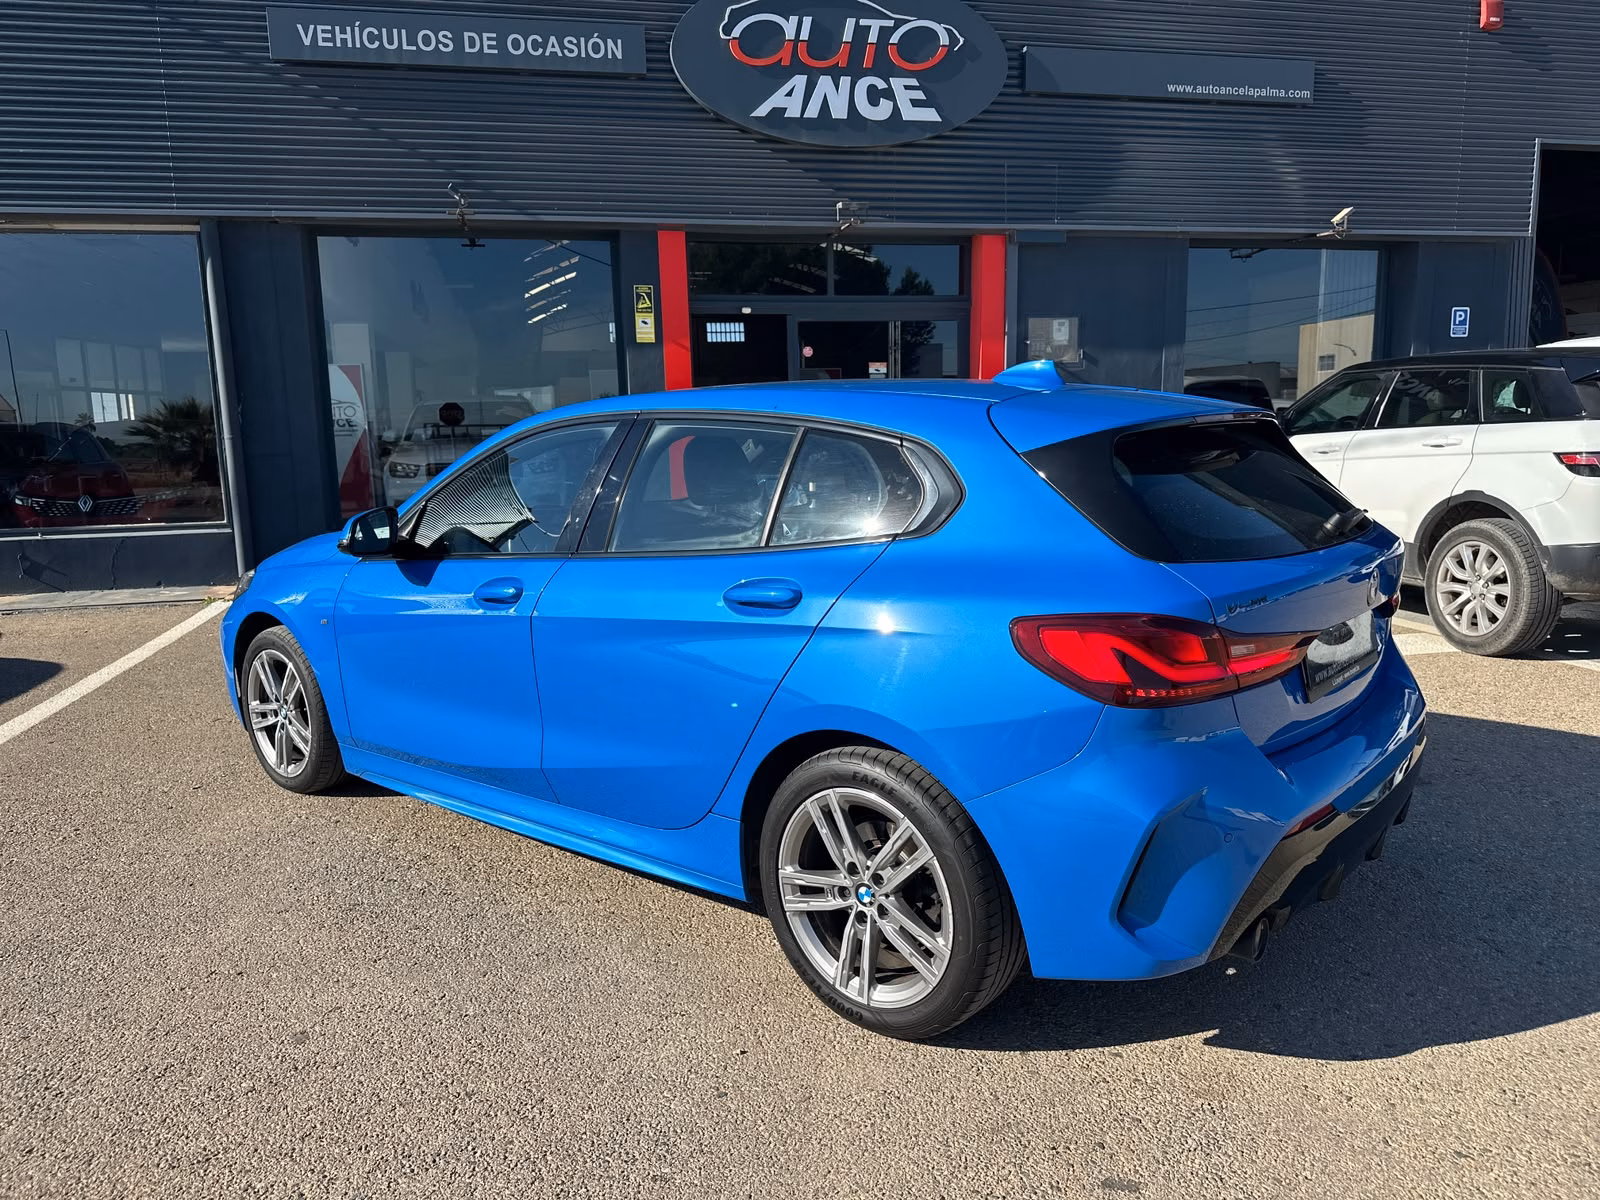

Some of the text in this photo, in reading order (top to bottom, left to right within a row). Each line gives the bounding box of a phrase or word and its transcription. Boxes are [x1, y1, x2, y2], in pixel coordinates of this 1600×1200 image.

[297, 21, 623, 60] VEHÍCULOS DE OCASIÓN
[749, 74, 943, 122] ANCE
[1167, 84, 1311, 98] www.autoancelapalma.com
[1455, 311, 1466, 325] P
[852, 771, 897, 797] EAGLE
